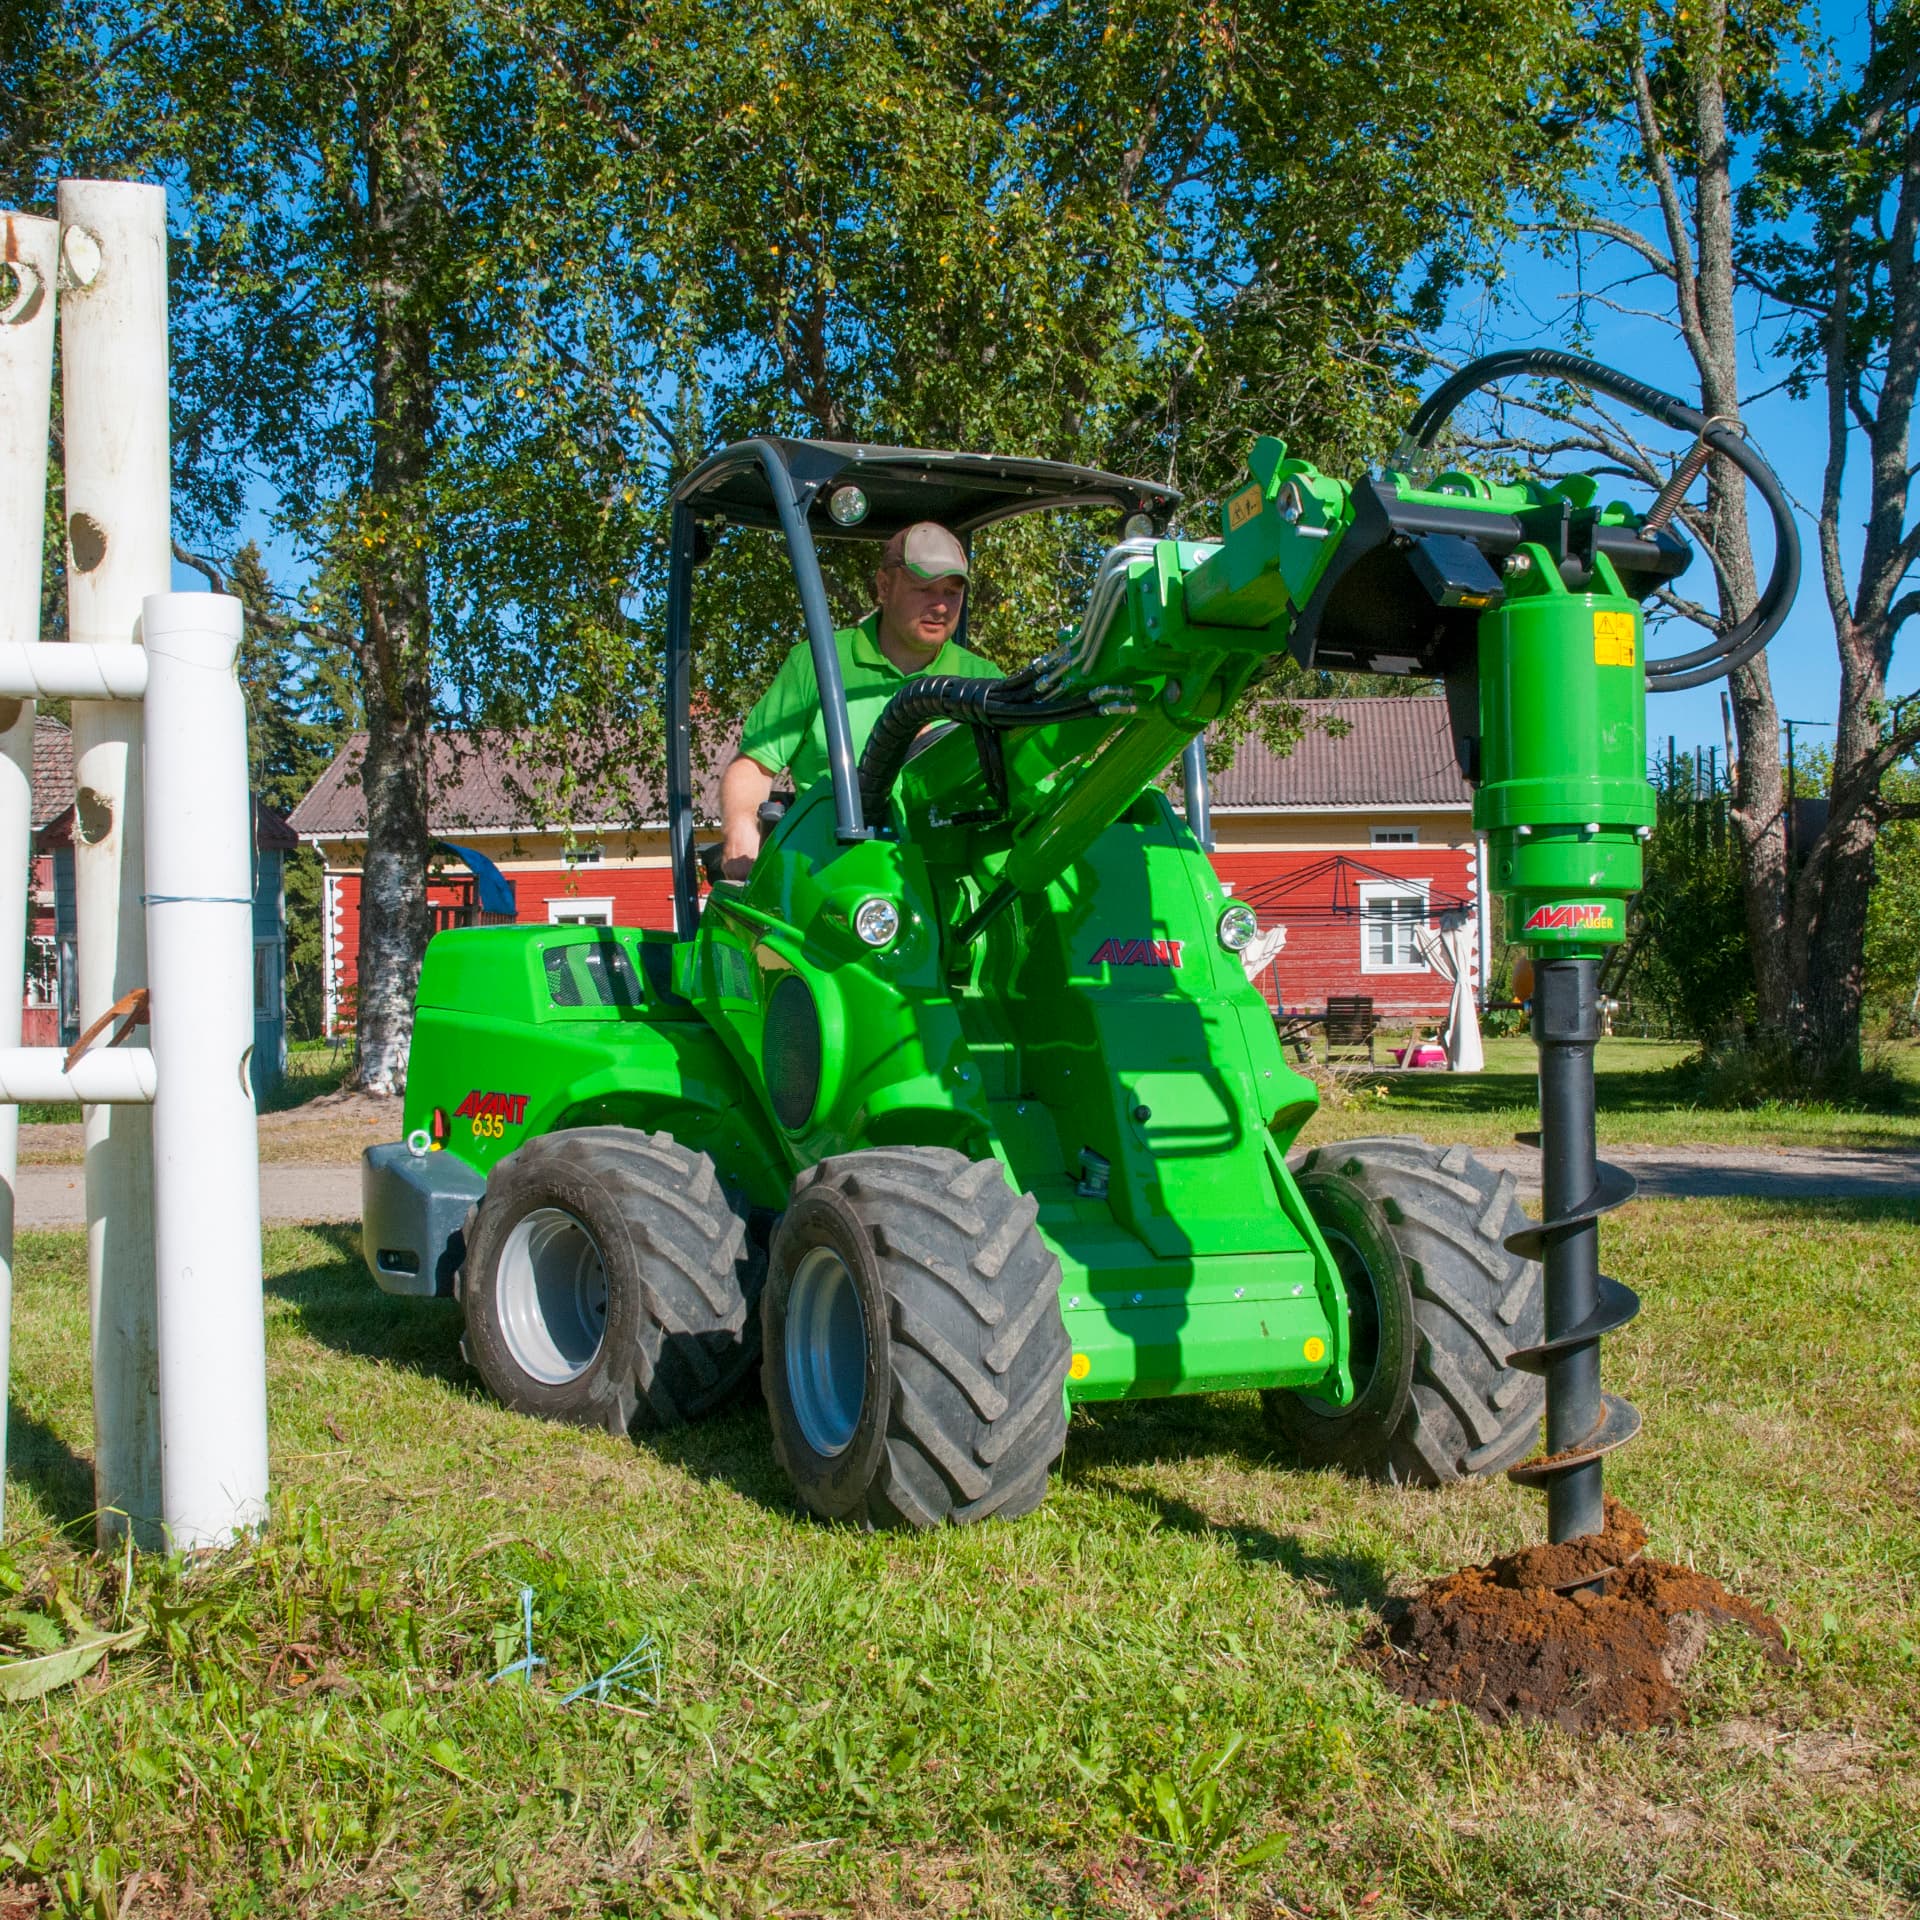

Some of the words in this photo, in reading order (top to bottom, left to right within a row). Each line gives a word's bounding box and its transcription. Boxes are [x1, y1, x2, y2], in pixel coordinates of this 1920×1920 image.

[1523, 905, 1606, 929] AVANT
[1088, 938, 1184, 968] AVANT
[453, 1089, 530, 1125] AVANT
[472, 1112, 504, 1139] 635
